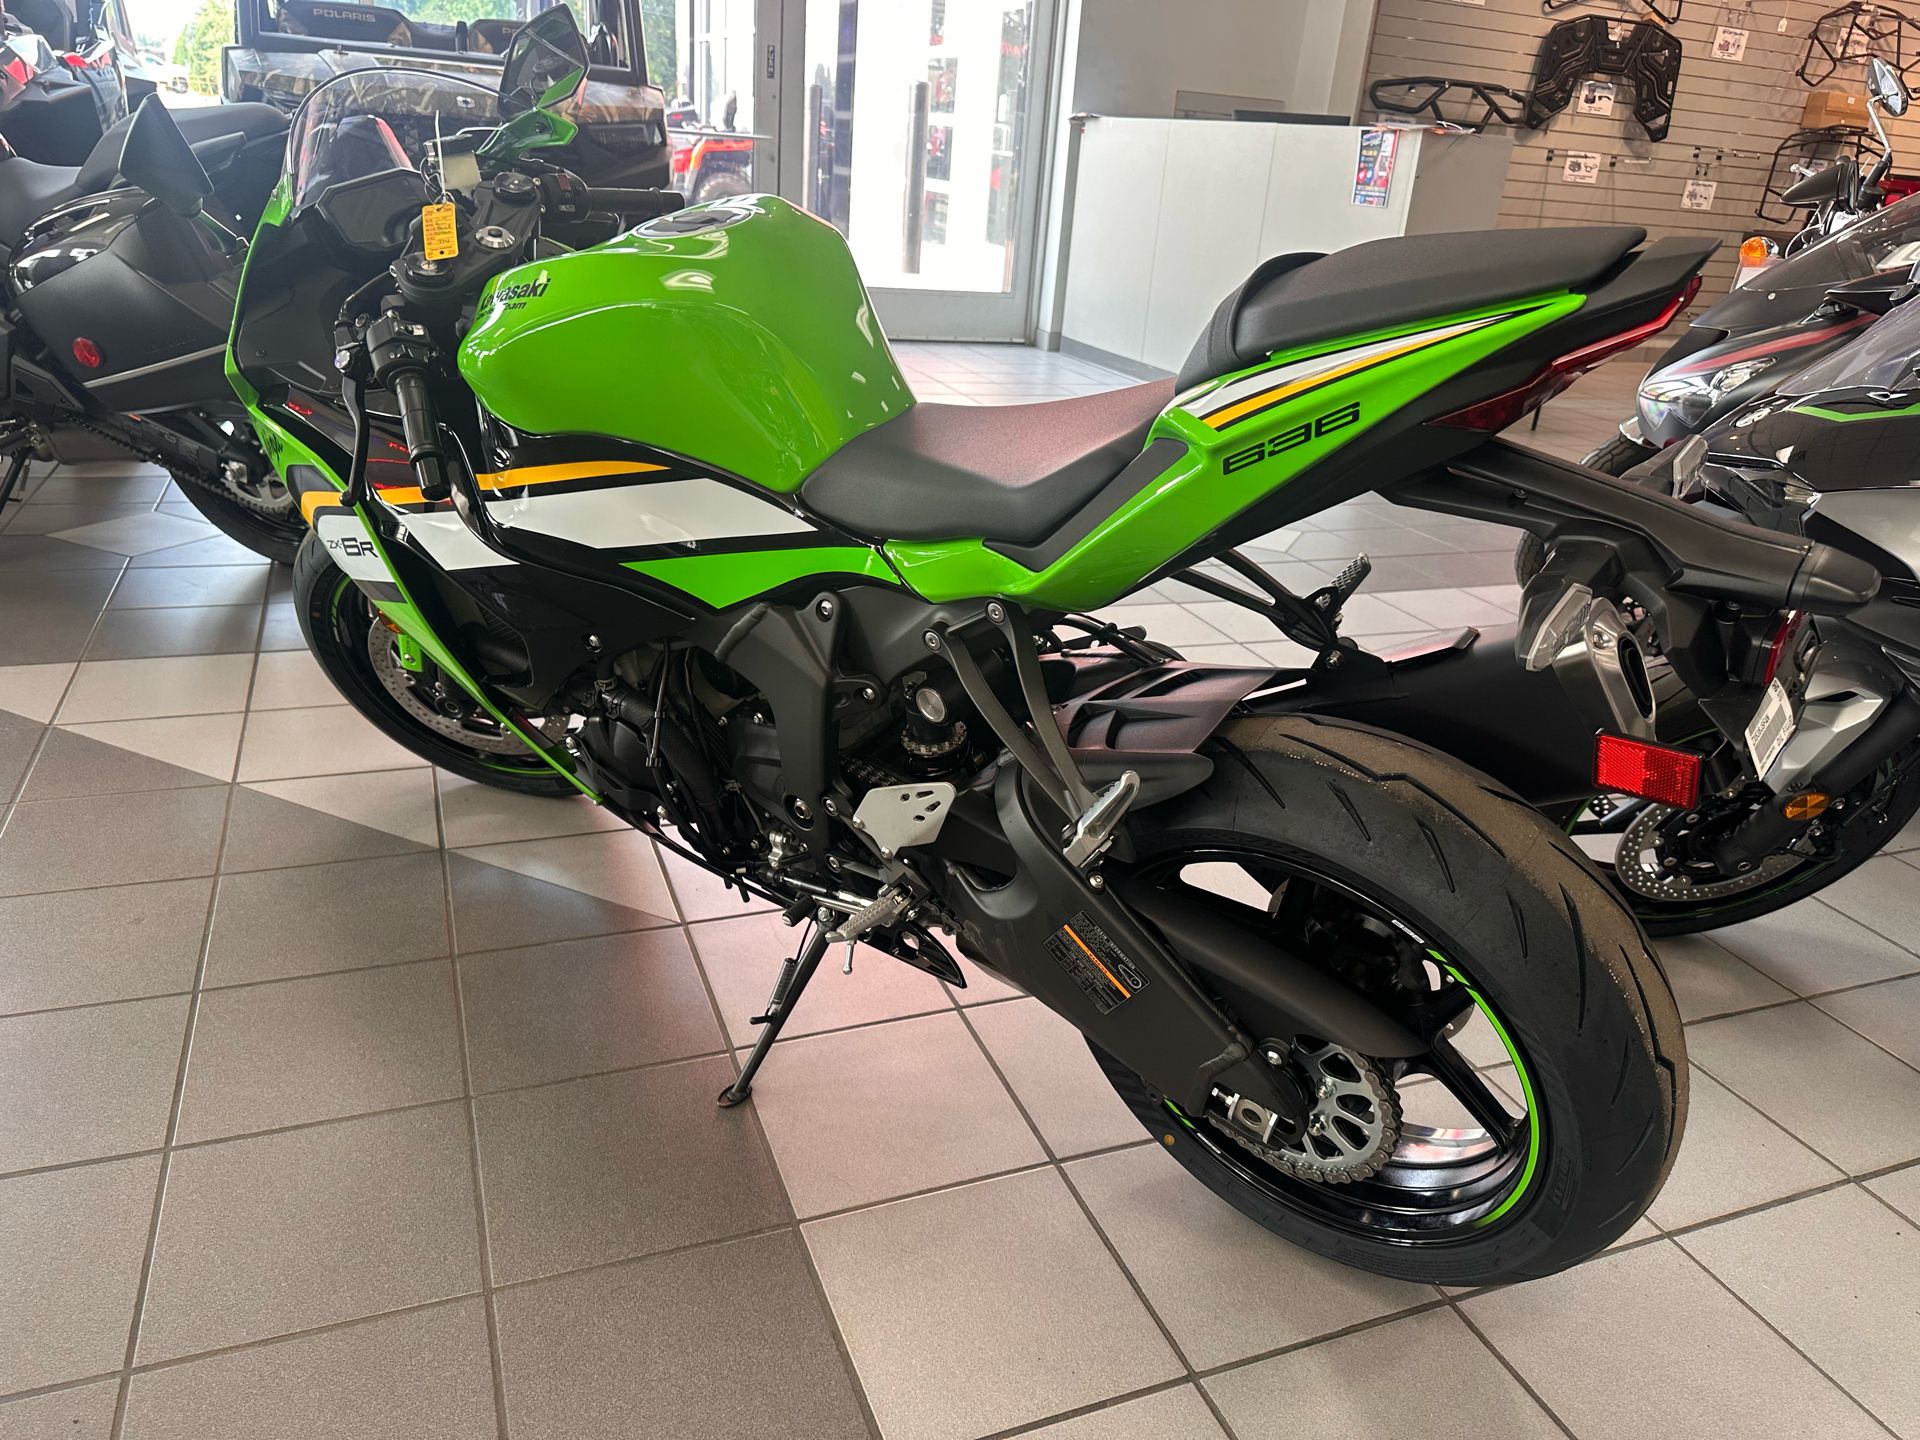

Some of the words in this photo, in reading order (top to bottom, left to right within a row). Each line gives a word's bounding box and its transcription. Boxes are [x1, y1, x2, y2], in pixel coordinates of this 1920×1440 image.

[313, 7, 376, 23] POLARIS
[1222, 401, 1360, 475] 636
[326, 537, 378, 558] ZX-6R
